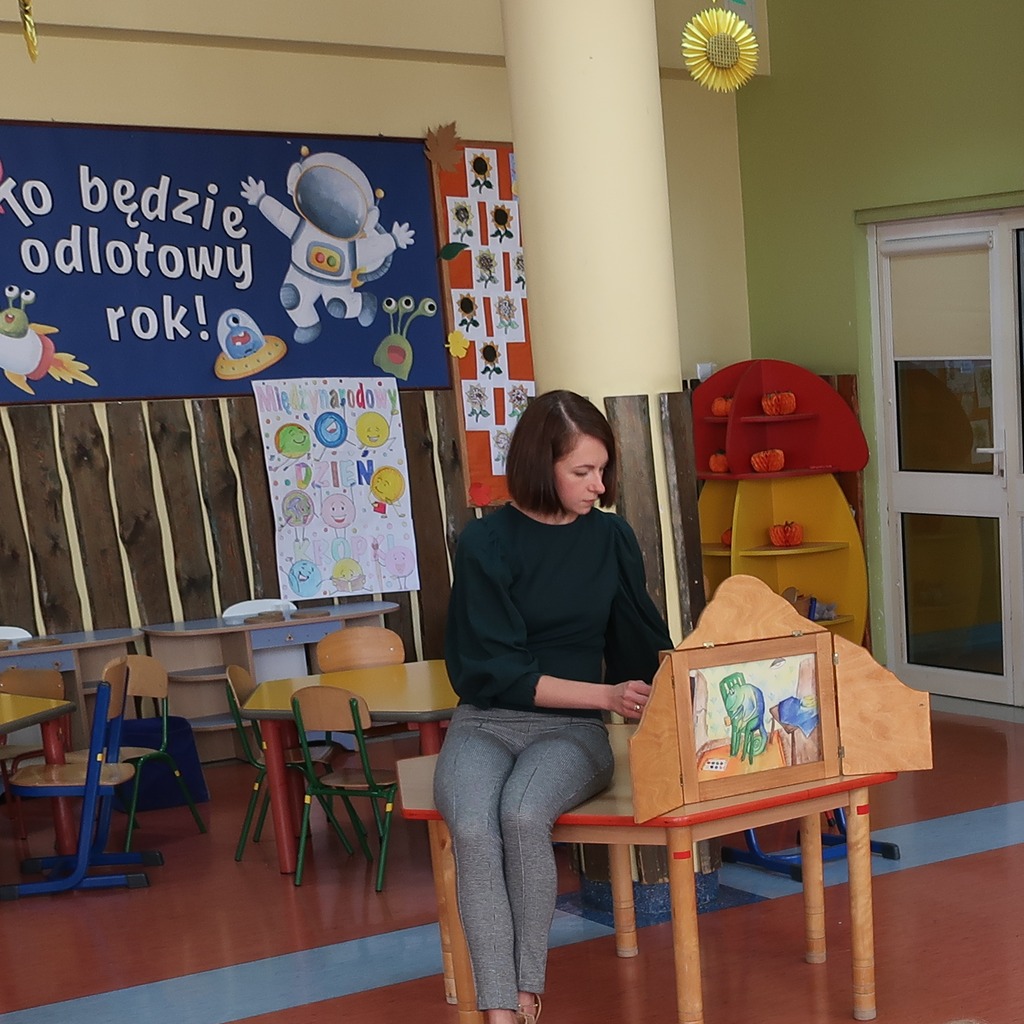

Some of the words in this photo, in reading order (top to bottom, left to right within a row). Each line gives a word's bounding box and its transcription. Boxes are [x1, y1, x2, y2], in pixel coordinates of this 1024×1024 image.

[79, 164, 248, 240] będzie
[20, 224, 253, 290] odlotowy
[106, 294, 210, 342] rok!
[255, 382, 398, 415] Międzynarodowy
[295, 449, 375, 490] DZIEŃ
